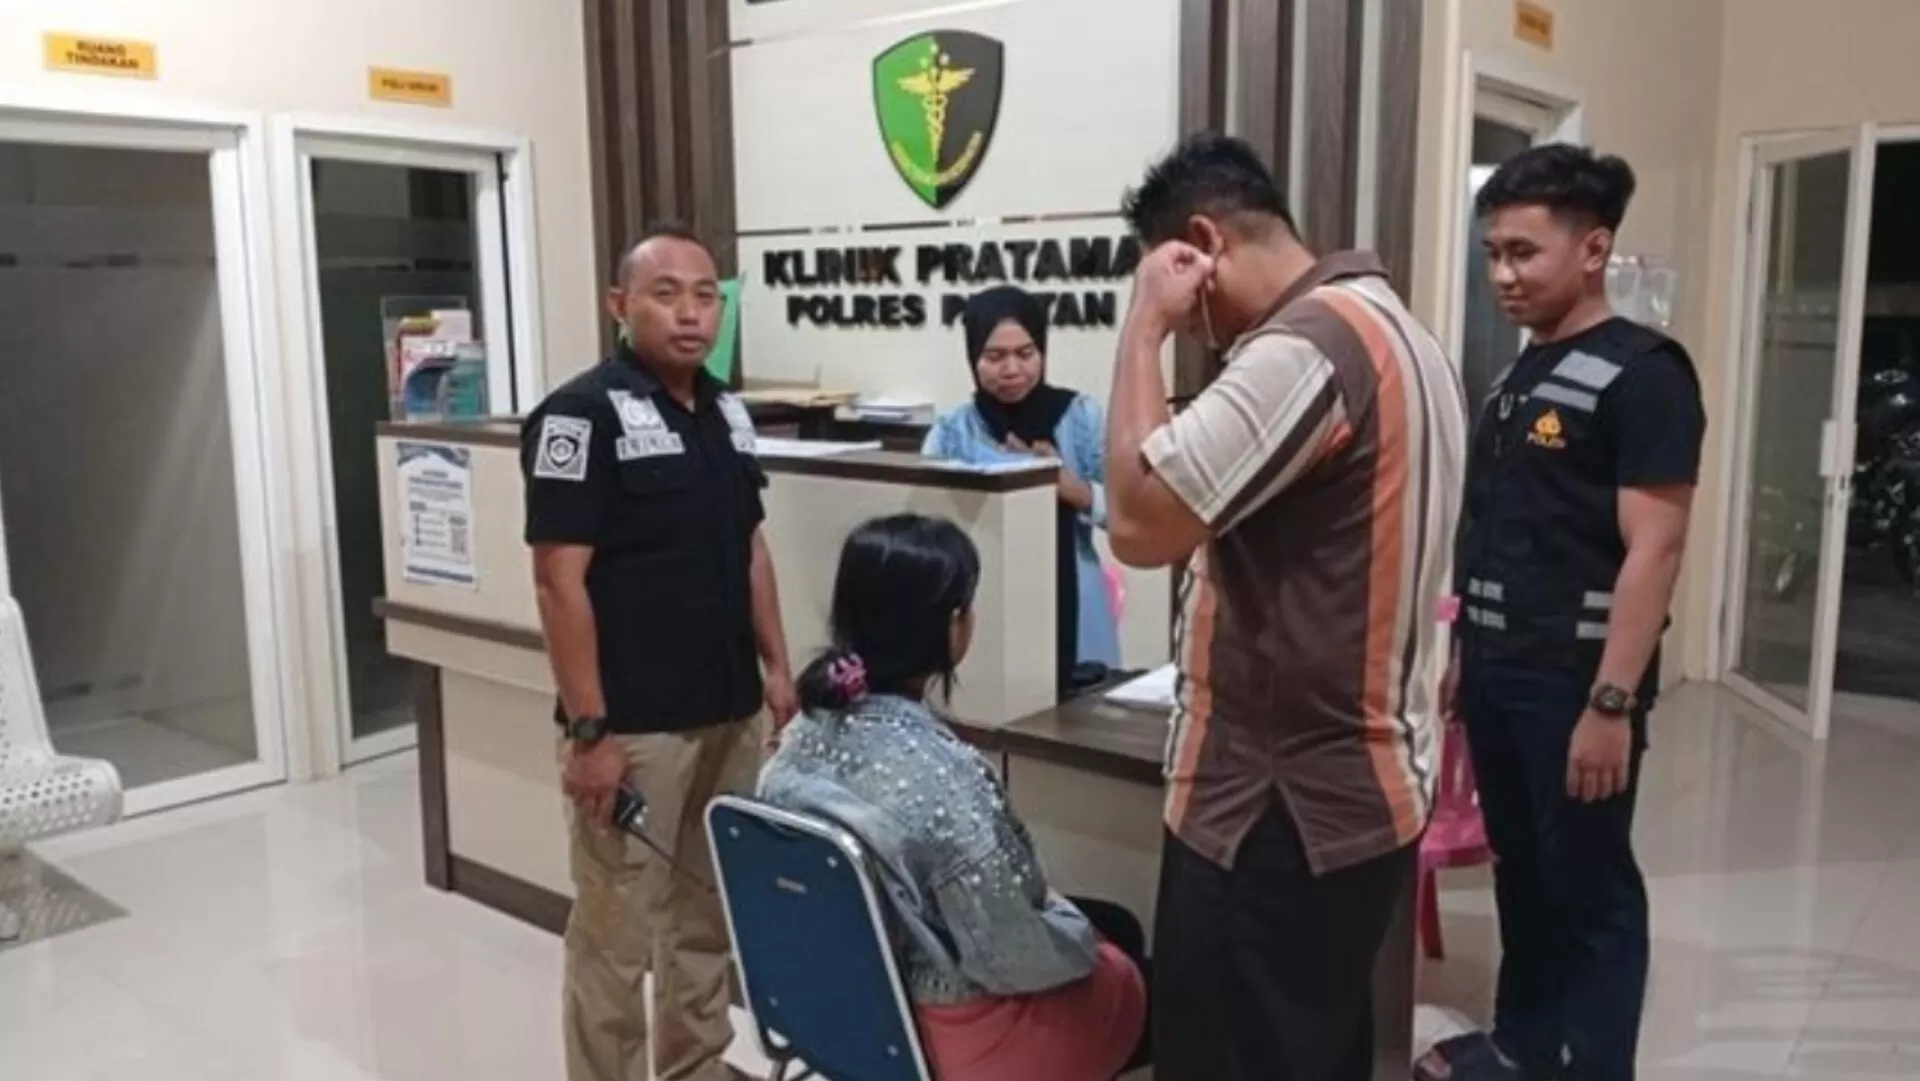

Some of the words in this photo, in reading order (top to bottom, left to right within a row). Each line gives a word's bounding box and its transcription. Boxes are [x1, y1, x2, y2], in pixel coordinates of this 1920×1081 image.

[65, 50, 139, 69] TINDAKAN
[76, 40, 126, 57] RUANG
[764, 246, 902, 287] KLINIK
[917, 236, 1142, 284] PRATAMA
[787, 294, 926, 328] POLRES
